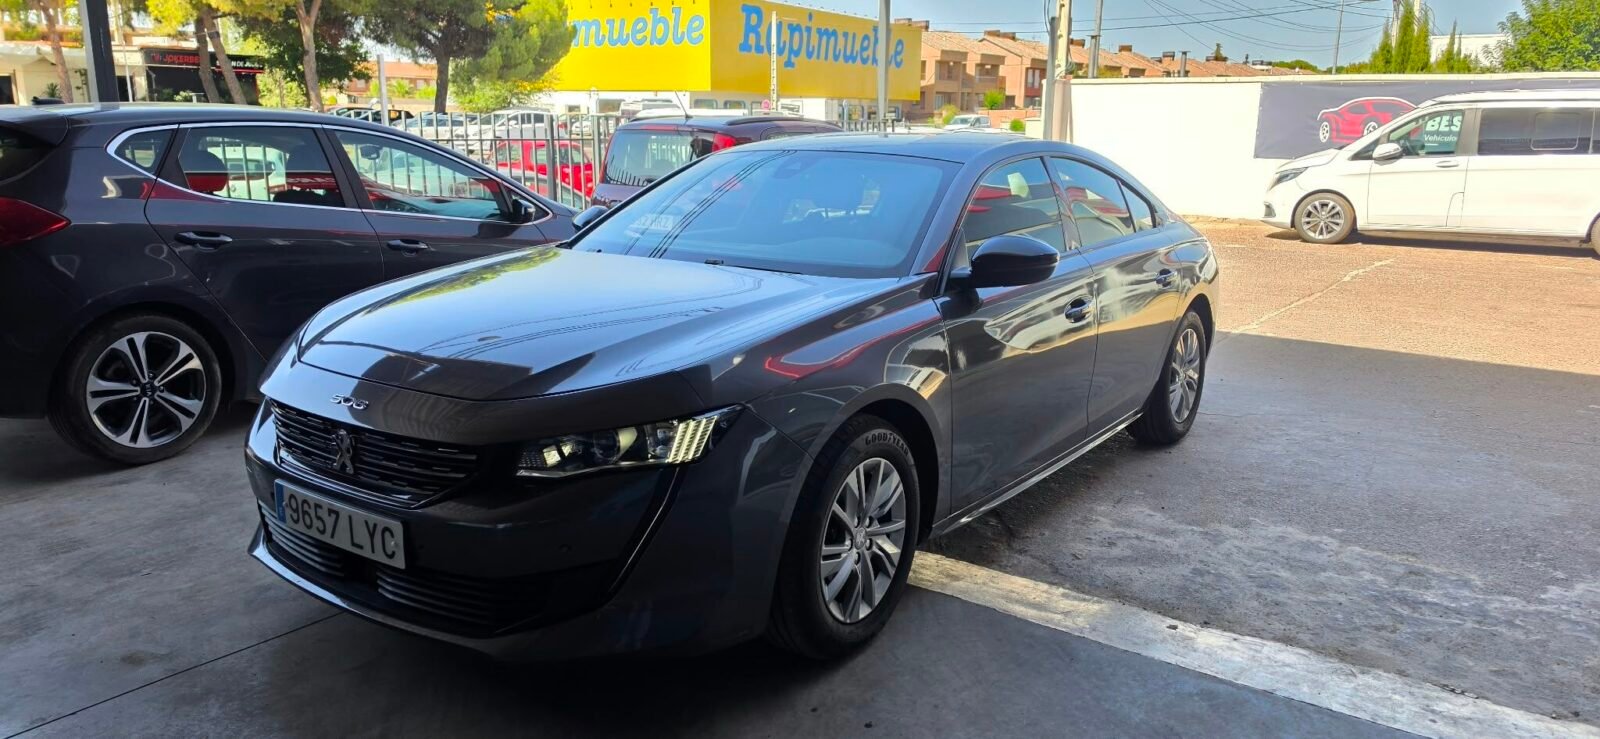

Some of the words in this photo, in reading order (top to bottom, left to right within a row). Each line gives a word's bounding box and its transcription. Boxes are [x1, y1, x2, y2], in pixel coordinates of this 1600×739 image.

[865, 432, 908, 455] GOODYEAR
[288, 493, 340, 539] 9657
[348, 514, 396, 560] LYC
